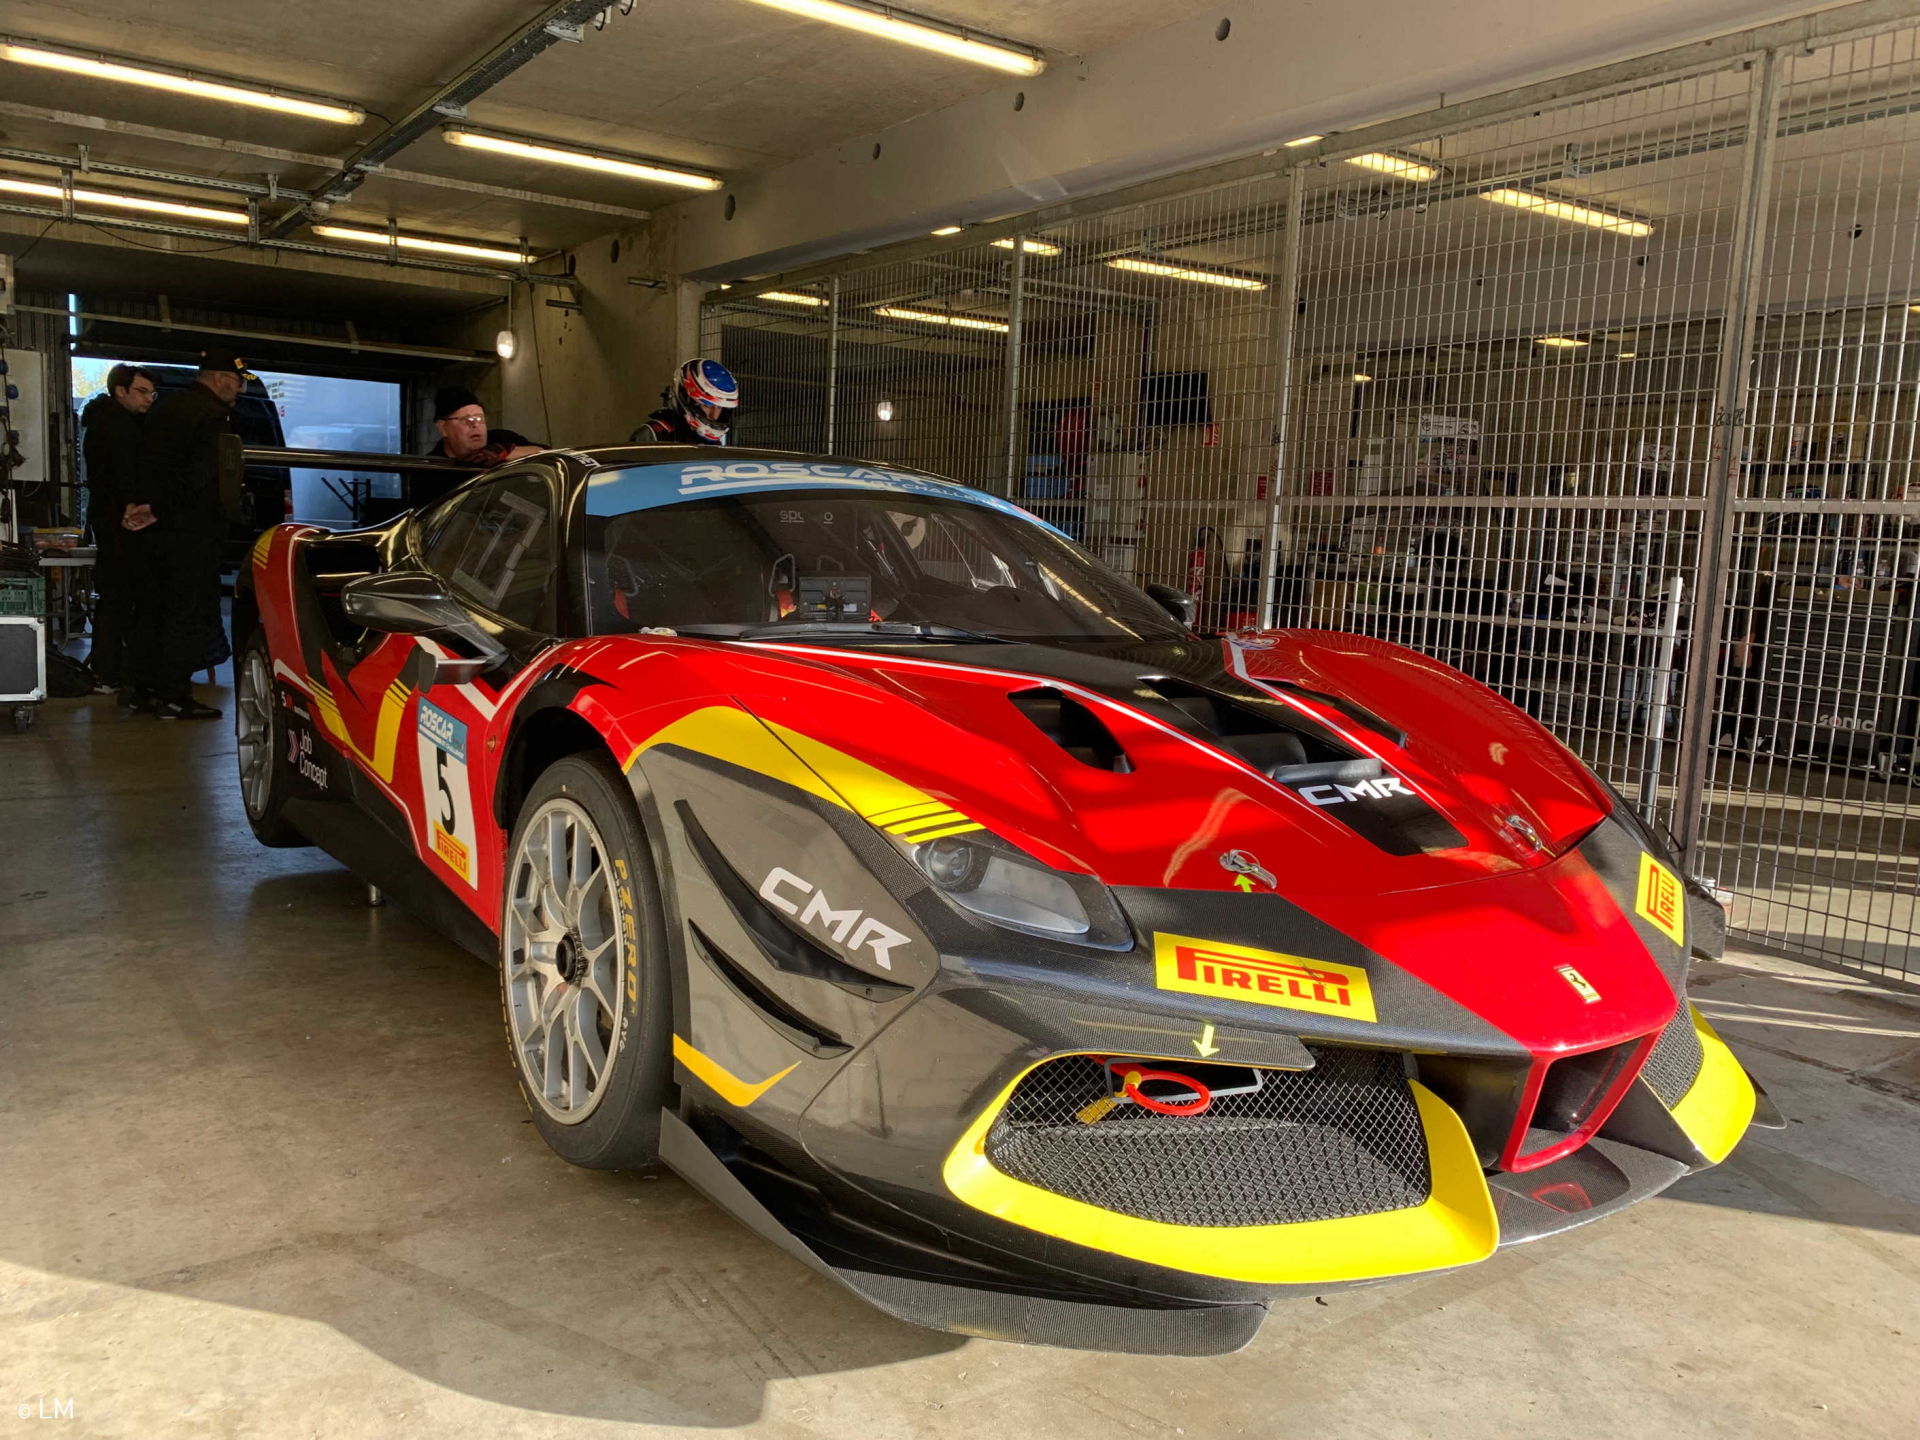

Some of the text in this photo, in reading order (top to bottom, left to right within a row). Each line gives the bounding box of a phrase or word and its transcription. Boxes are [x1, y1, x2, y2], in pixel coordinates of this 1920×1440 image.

[681, 463, 927, 486] ROSCAR
[300, 728, 312, 754] Job
[420, 705, 454, 742] ROSCAR
[300, 751, 328, 790] Concept
[436, 746, 456, 835] 5
[1298, 777, 1416, 806] CMR
[436, 828, 467, 874] PIRELLI
[759, 867, 912, 970] CMR
[1646, 864, 1675, 931] PIRELLI
[1175, 946, 1351, 1007] PIRELLI
